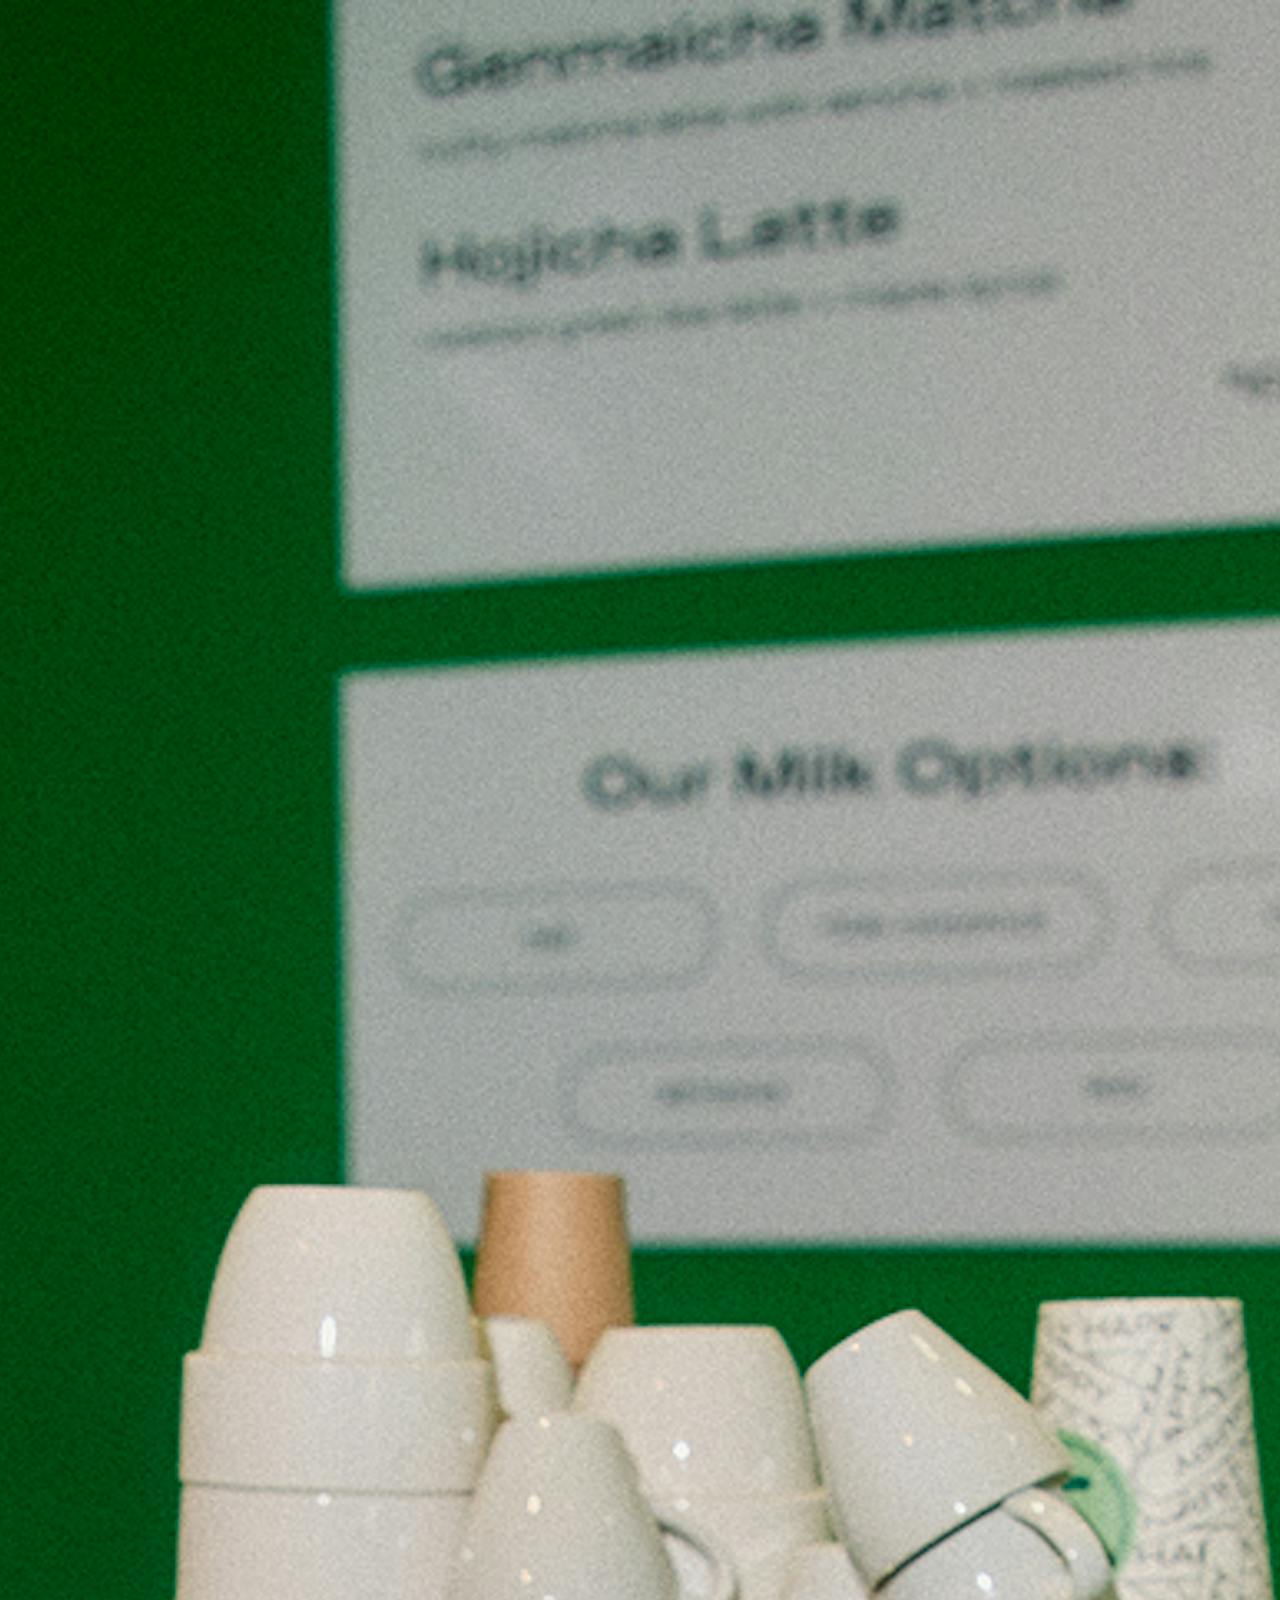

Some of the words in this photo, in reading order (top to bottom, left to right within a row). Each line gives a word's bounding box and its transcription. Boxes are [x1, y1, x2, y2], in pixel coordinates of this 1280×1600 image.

[414, 8, 822, 98] Genmaicha
[418, 212, 683, 288] Hojicha
[700, 198, 904, 262] Latte
[581, 752, 712, 812] Our
[732, 740, 874, 799] Milk
[895, 736, 1212, 799] Options
